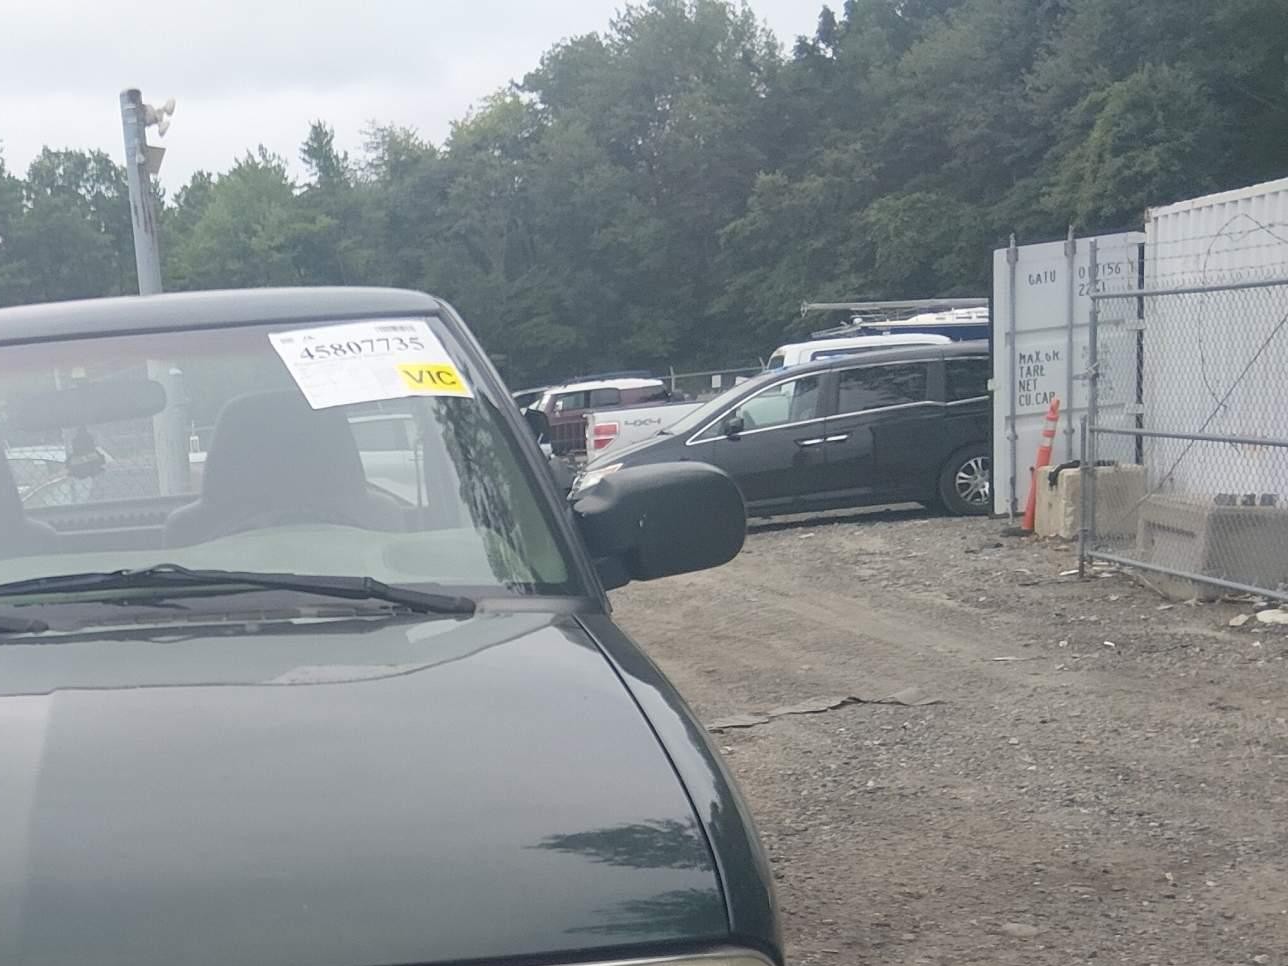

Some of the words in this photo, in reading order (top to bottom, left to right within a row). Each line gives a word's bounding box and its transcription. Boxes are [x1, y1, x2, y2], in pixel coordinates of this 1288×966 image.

[1028, 269, 1056, 286] GATU
[299, 336, 425, 361] 45807735
[403, 369, 457, 386] VIC
[1019, 365, 1046, 378] TARE
[1019, 378, 1038, 393] NET
